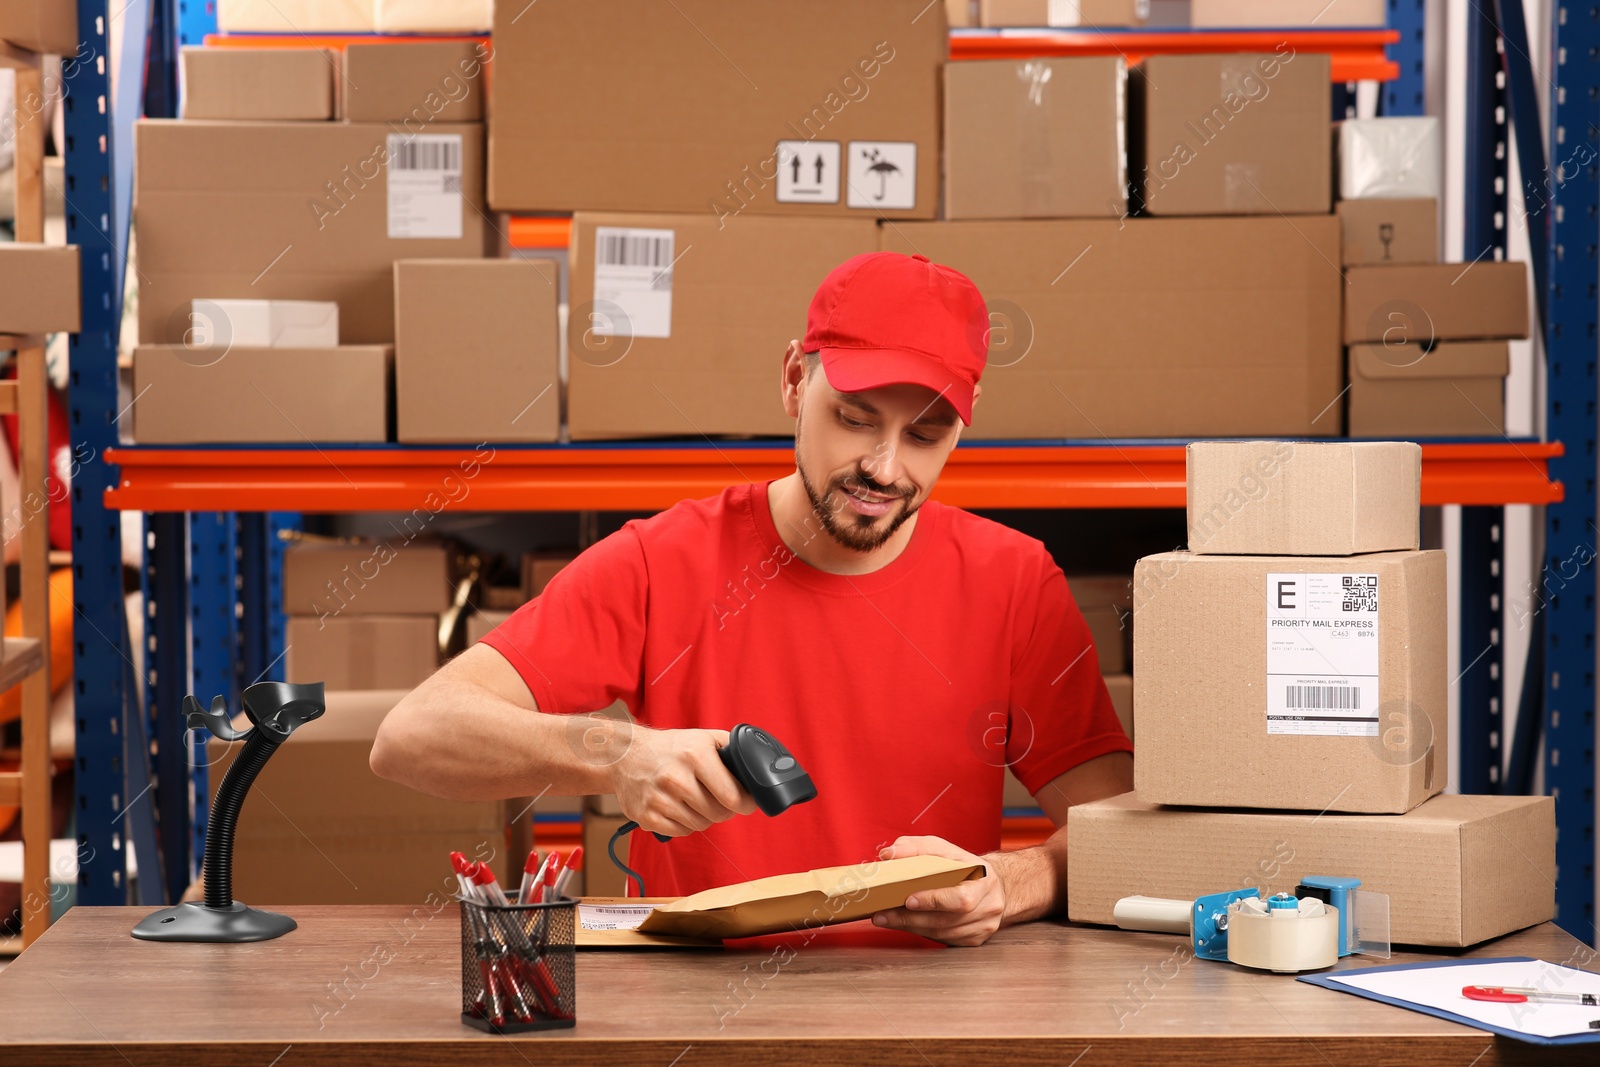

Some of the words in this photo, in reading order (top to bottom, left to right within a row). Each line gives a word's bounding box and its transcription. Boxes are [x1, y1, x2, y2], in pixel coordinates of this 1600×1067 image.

[1278, 581, 1296, 609] E
[1271, 619, 1311, 628] PRIORITY
[1312, 620, 1332, 628] MAIL
[1334, 620, 1374, 629] EXPRESS
